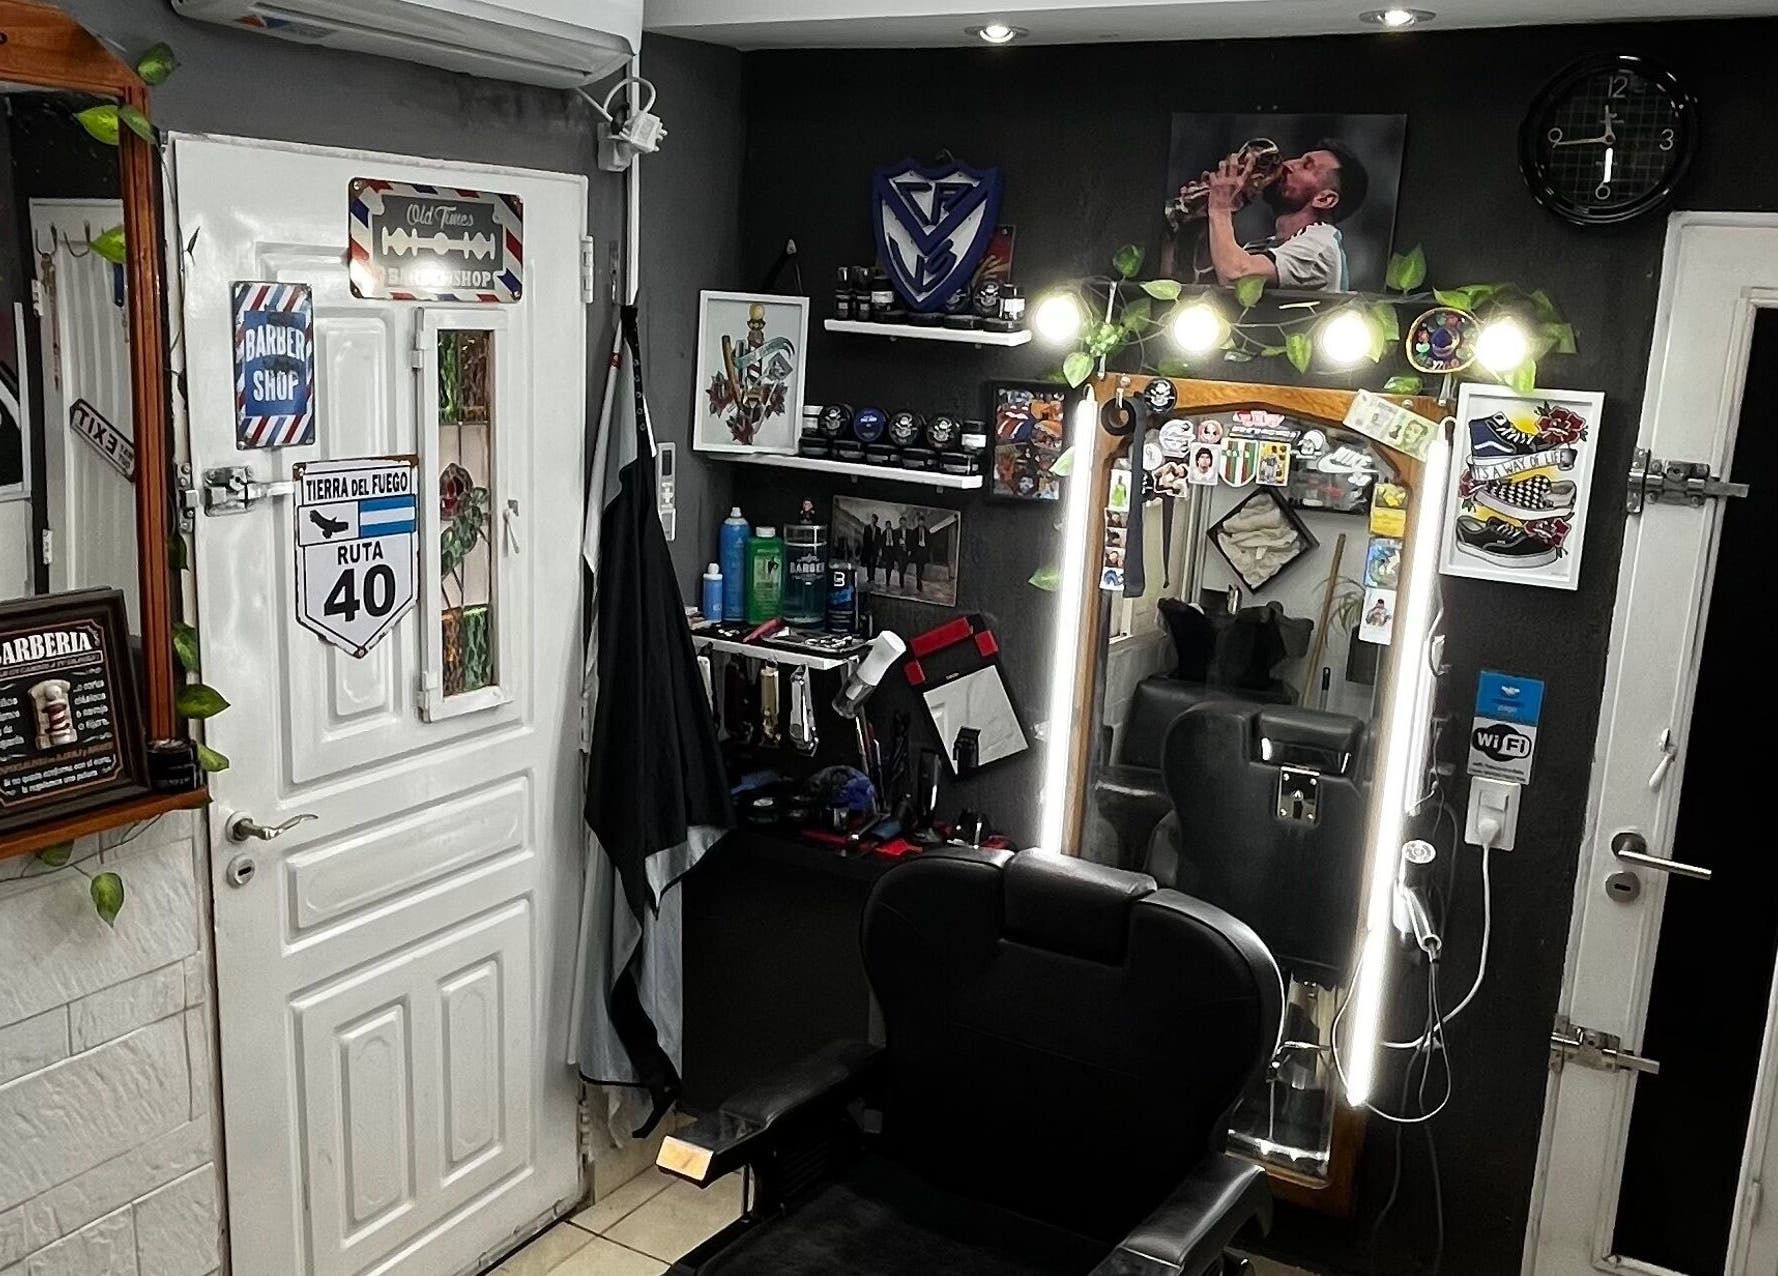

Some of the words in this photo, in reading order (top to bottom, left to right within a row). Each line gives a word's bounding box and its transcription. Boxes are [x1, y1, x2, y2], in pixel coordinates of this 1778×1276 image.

[1607, 75, 1628, 98] 12
[1659, 128, 1675, 151] 3
[406, 203, 433, 226] Old
[245, 323, 306, 362] BARBER
[252, 370, 300, 402] SHOP
[1503, 458, 1527, 473] WAY
[1545, 450, 1565, 464] LIFE
[306, 476, 349, 501] TIERRA
[351, 478, 369, 497] DEL
[372, 472, 408, 495] FUEGO
[337, 540, 384, 566] RUTA
[323, 564, 396, 622] 40
[0, 631, 92, 665] ARBERIA
